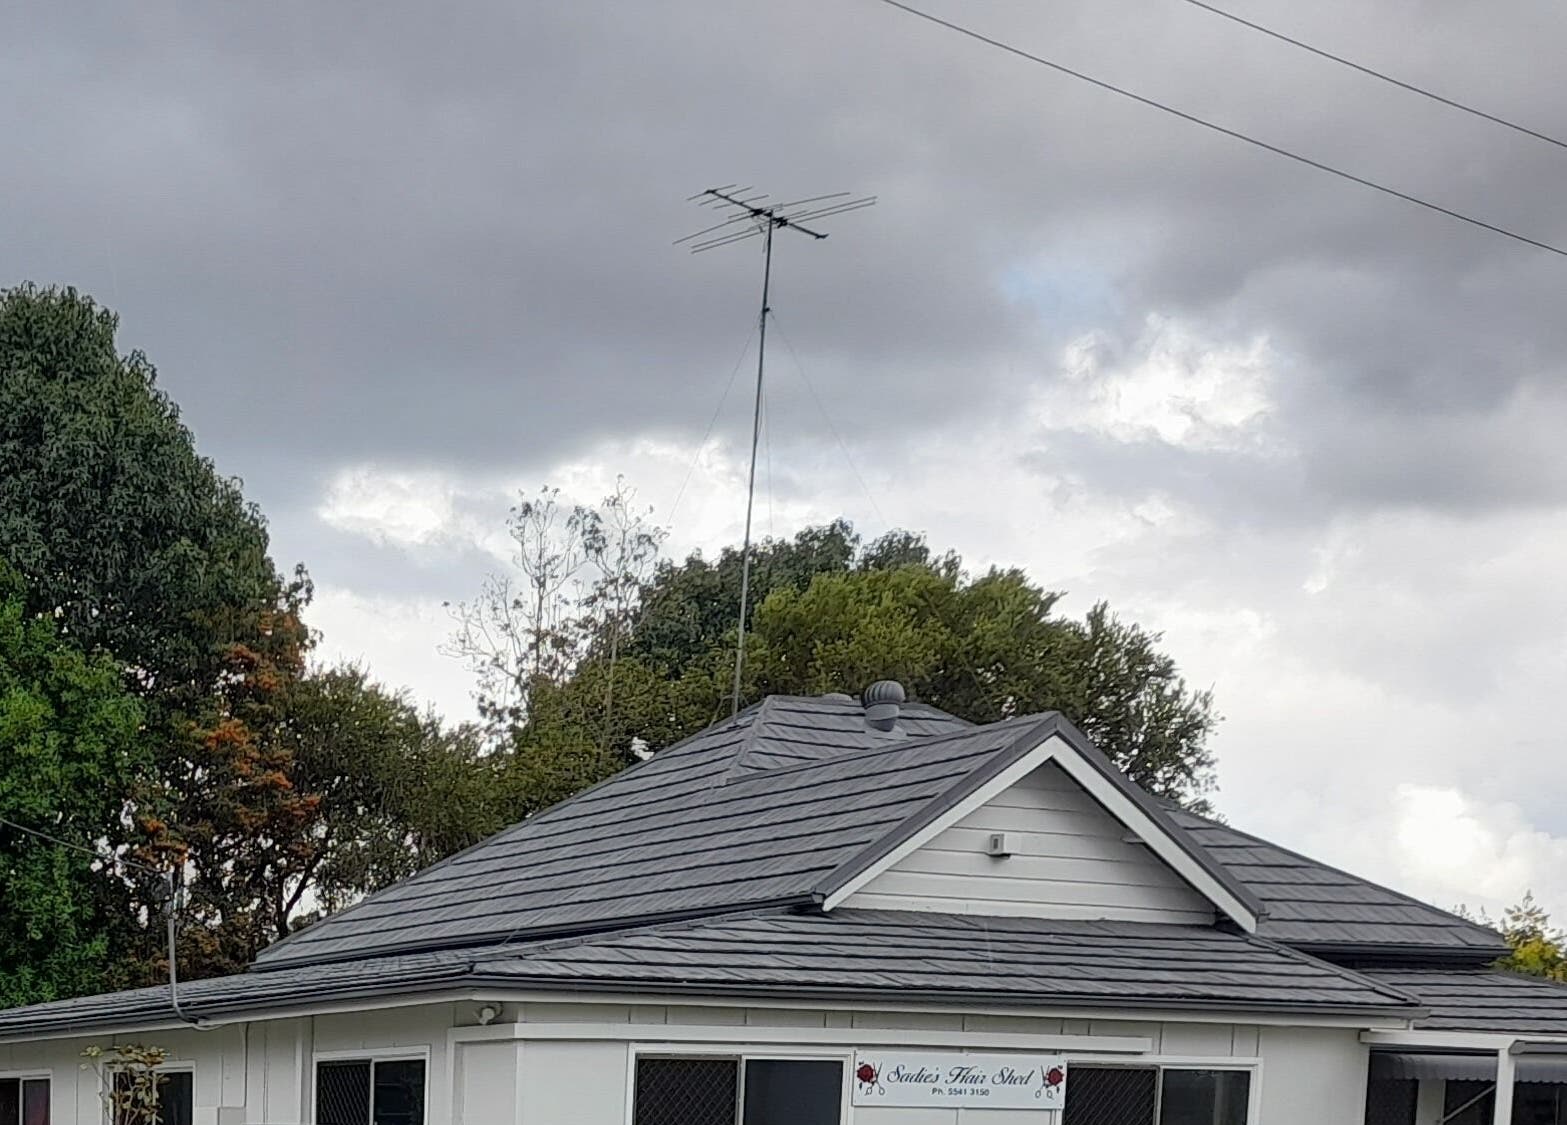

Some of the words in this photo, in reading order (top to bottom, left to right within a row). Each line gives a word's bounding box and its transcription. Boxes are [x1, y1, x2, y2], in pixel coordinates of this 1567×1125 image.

[886, 1064, 940, 1084] Sadie's
[945, 1066, 986, 1085] Hair
[992, 1067, 1035, 1086] Shed
